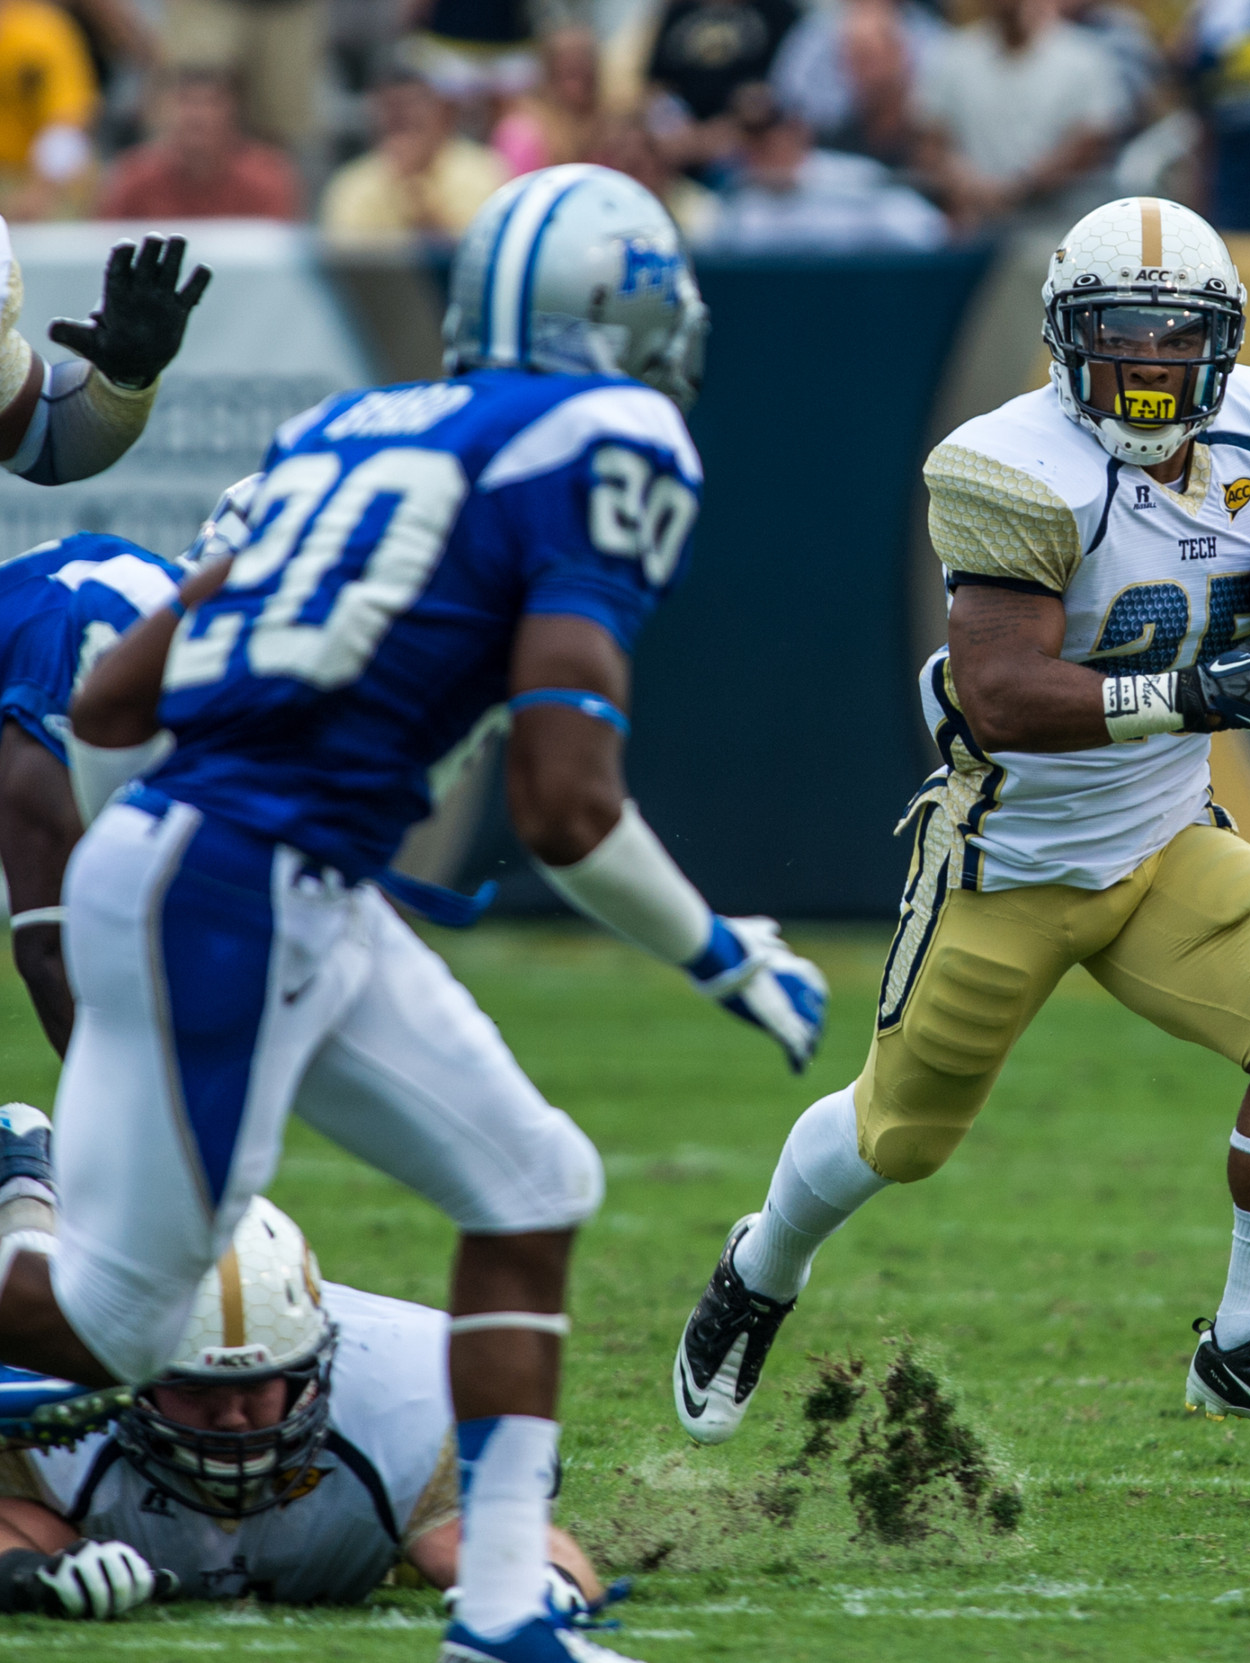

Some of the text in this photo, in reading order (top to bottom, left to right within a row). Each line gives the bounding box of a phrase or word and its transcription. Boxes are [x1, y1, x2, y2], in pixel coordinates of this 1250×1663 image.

[1135, 269, 1170, 282] ACC
[1227, 484, 1250, 504] ACC
[588, 443, 698, 588] 20
[1178, 536, 1217, 560] TECH
[159, 446, 470, 692] 20
